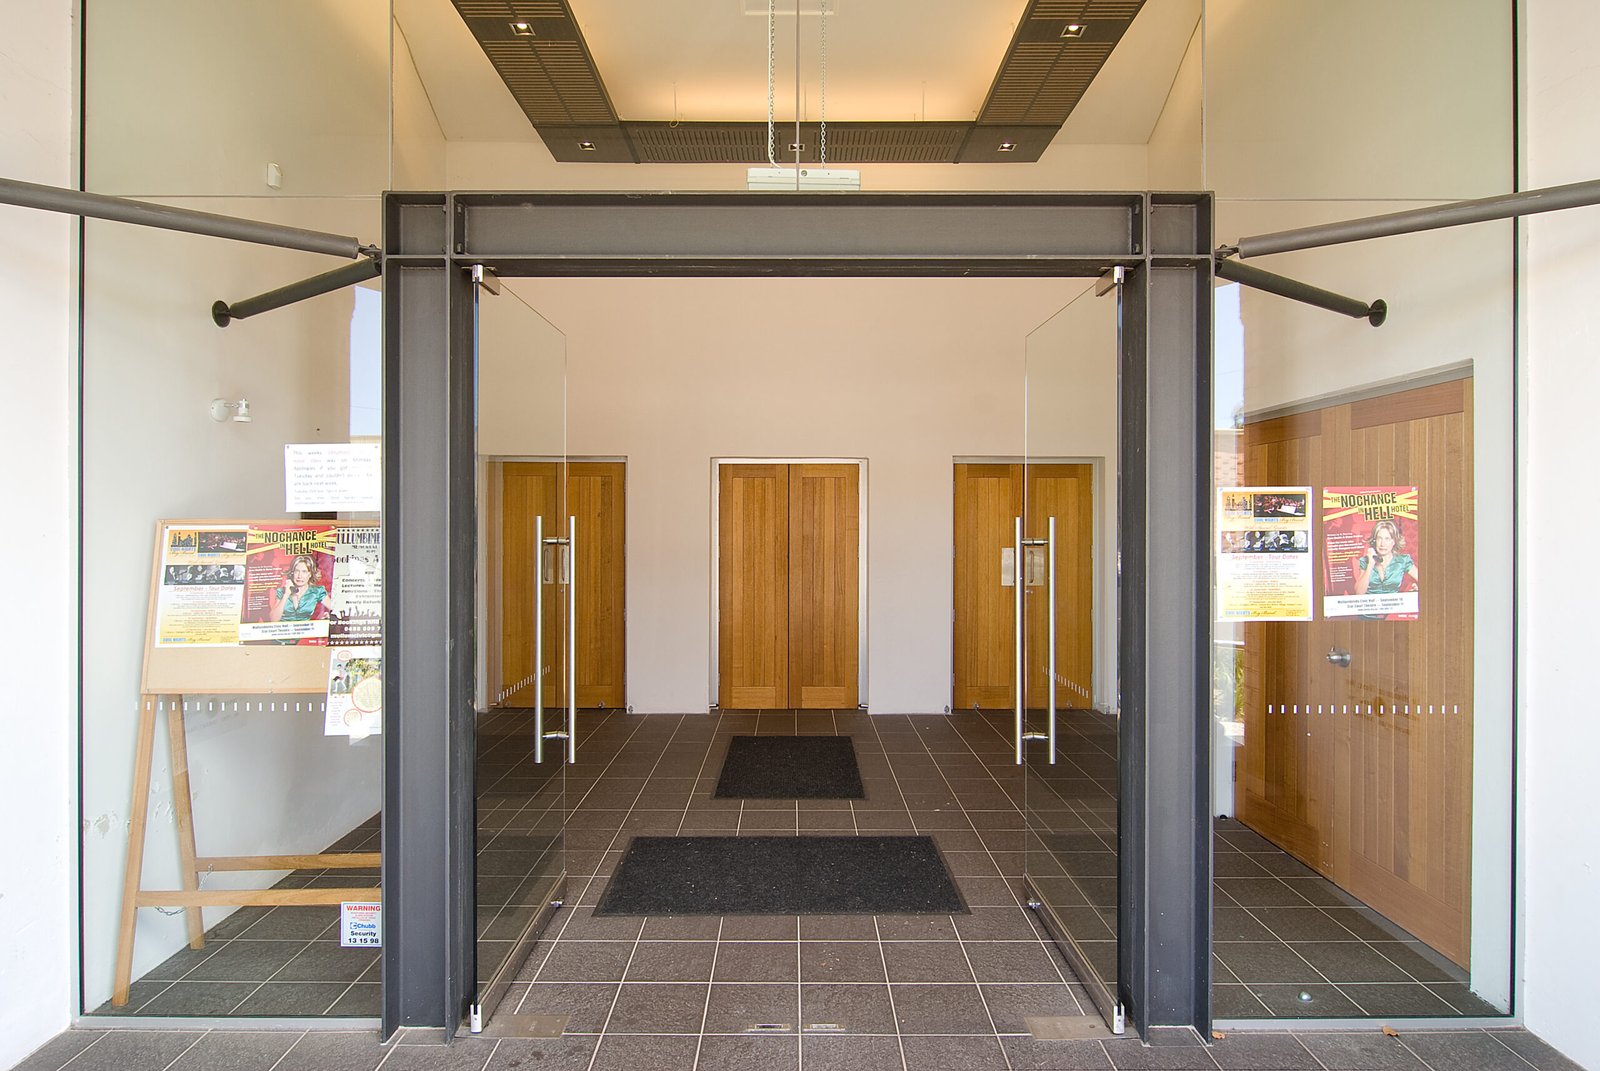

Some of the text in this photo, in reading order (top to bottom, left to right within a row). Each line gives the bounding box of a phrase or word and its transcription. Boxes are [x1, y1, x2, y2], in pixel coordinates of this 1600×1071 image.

[1340, 492, 1396, 507] NOCHANCE
[1364, 506, 1393, 520] HELL
[1391, 504, 1409, 512] HOTEL
[264, 530, 317, 543] NOCHANCE
[286, 543, 312, 555] HELL
